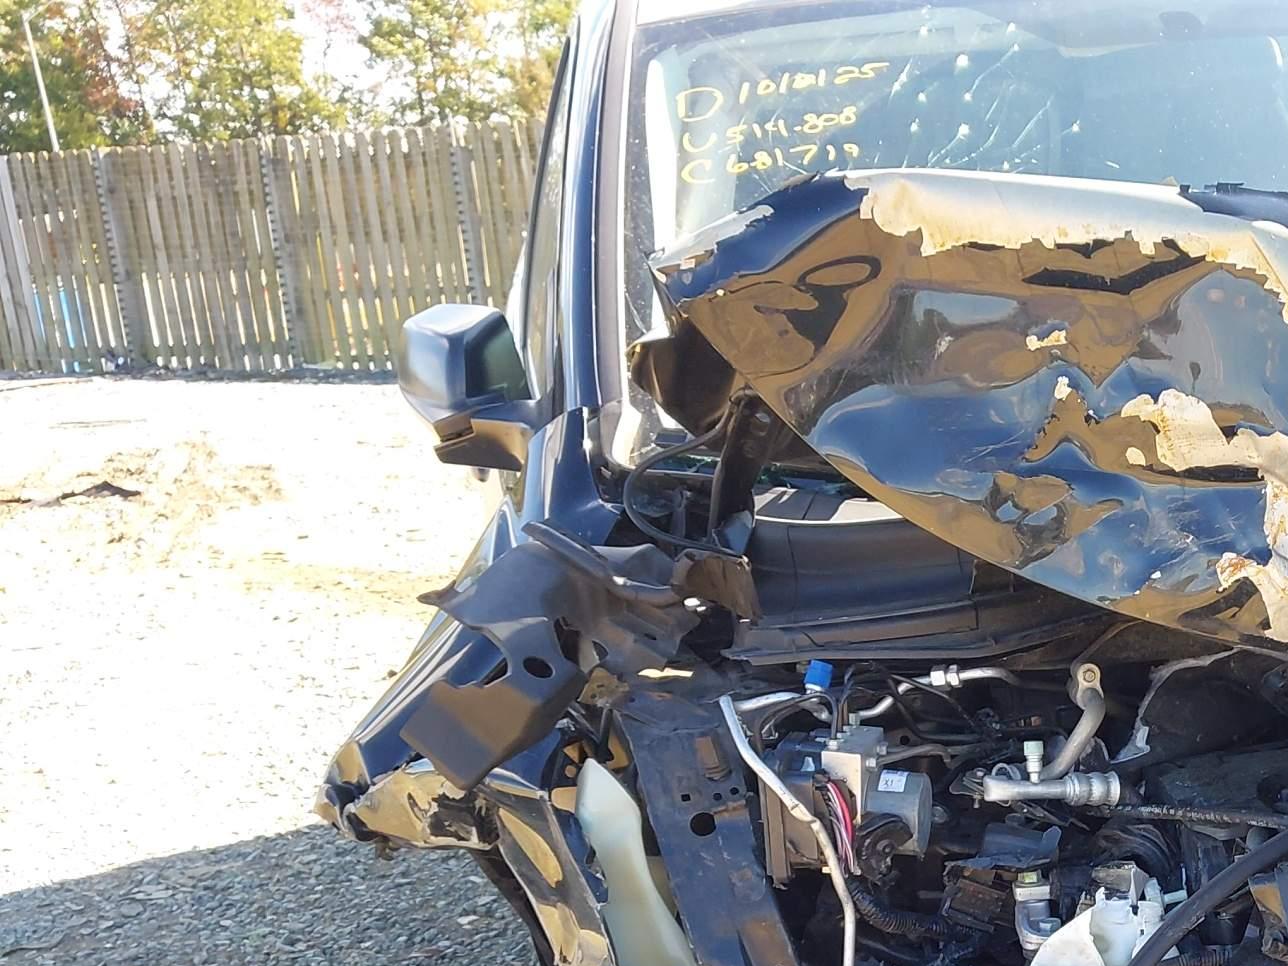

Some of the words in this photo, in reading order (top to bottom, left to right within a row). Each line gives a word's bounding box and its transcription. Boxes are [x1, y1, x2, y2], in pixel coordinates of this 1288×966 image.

[676, 87, 723, 122] D
[683, 132, 717, 152] U
[681, 159, 716, 184] C
